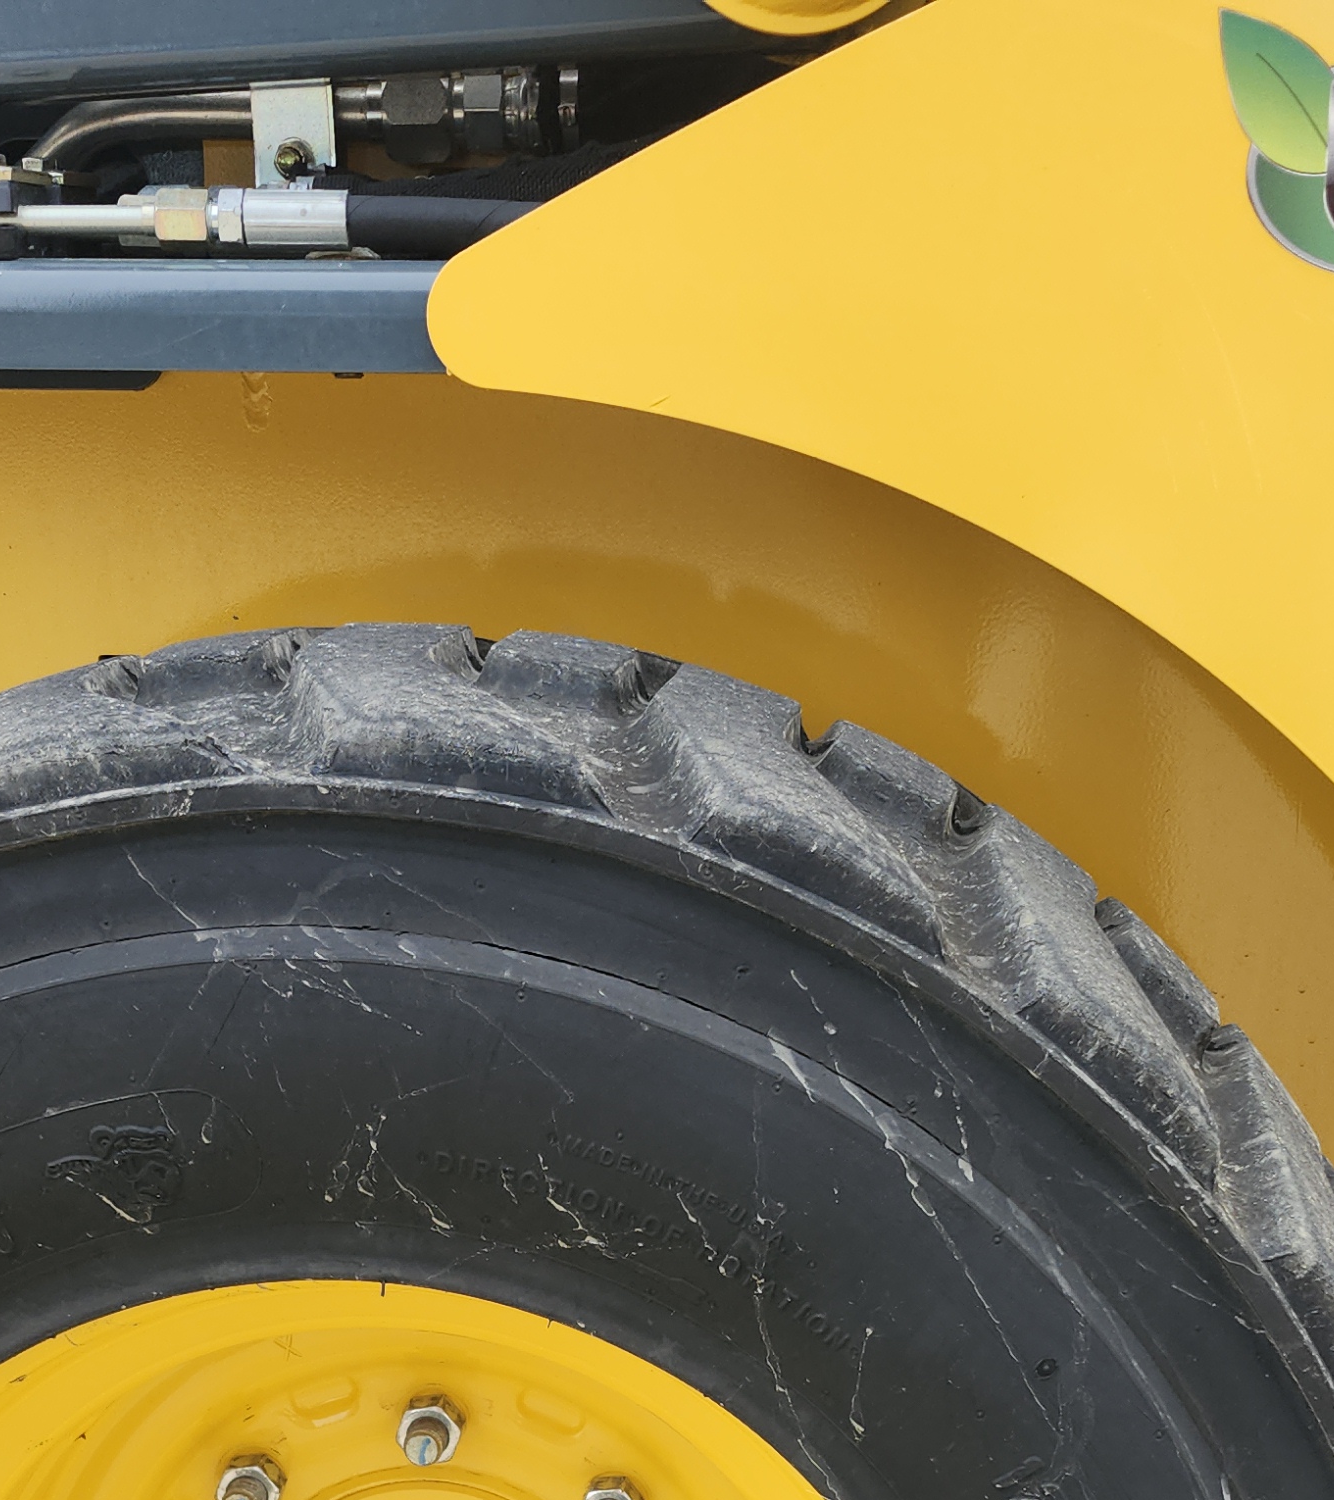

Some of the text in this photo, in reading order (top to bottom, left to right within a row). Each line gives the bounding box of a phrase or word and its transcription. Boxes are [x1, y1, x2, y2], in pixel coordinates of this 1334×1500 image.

[557, 1132, 639, 1176] MADE
[431, 1150, 627, 1222] DIRECTION
[637, 1211, 685, 1248] OF
